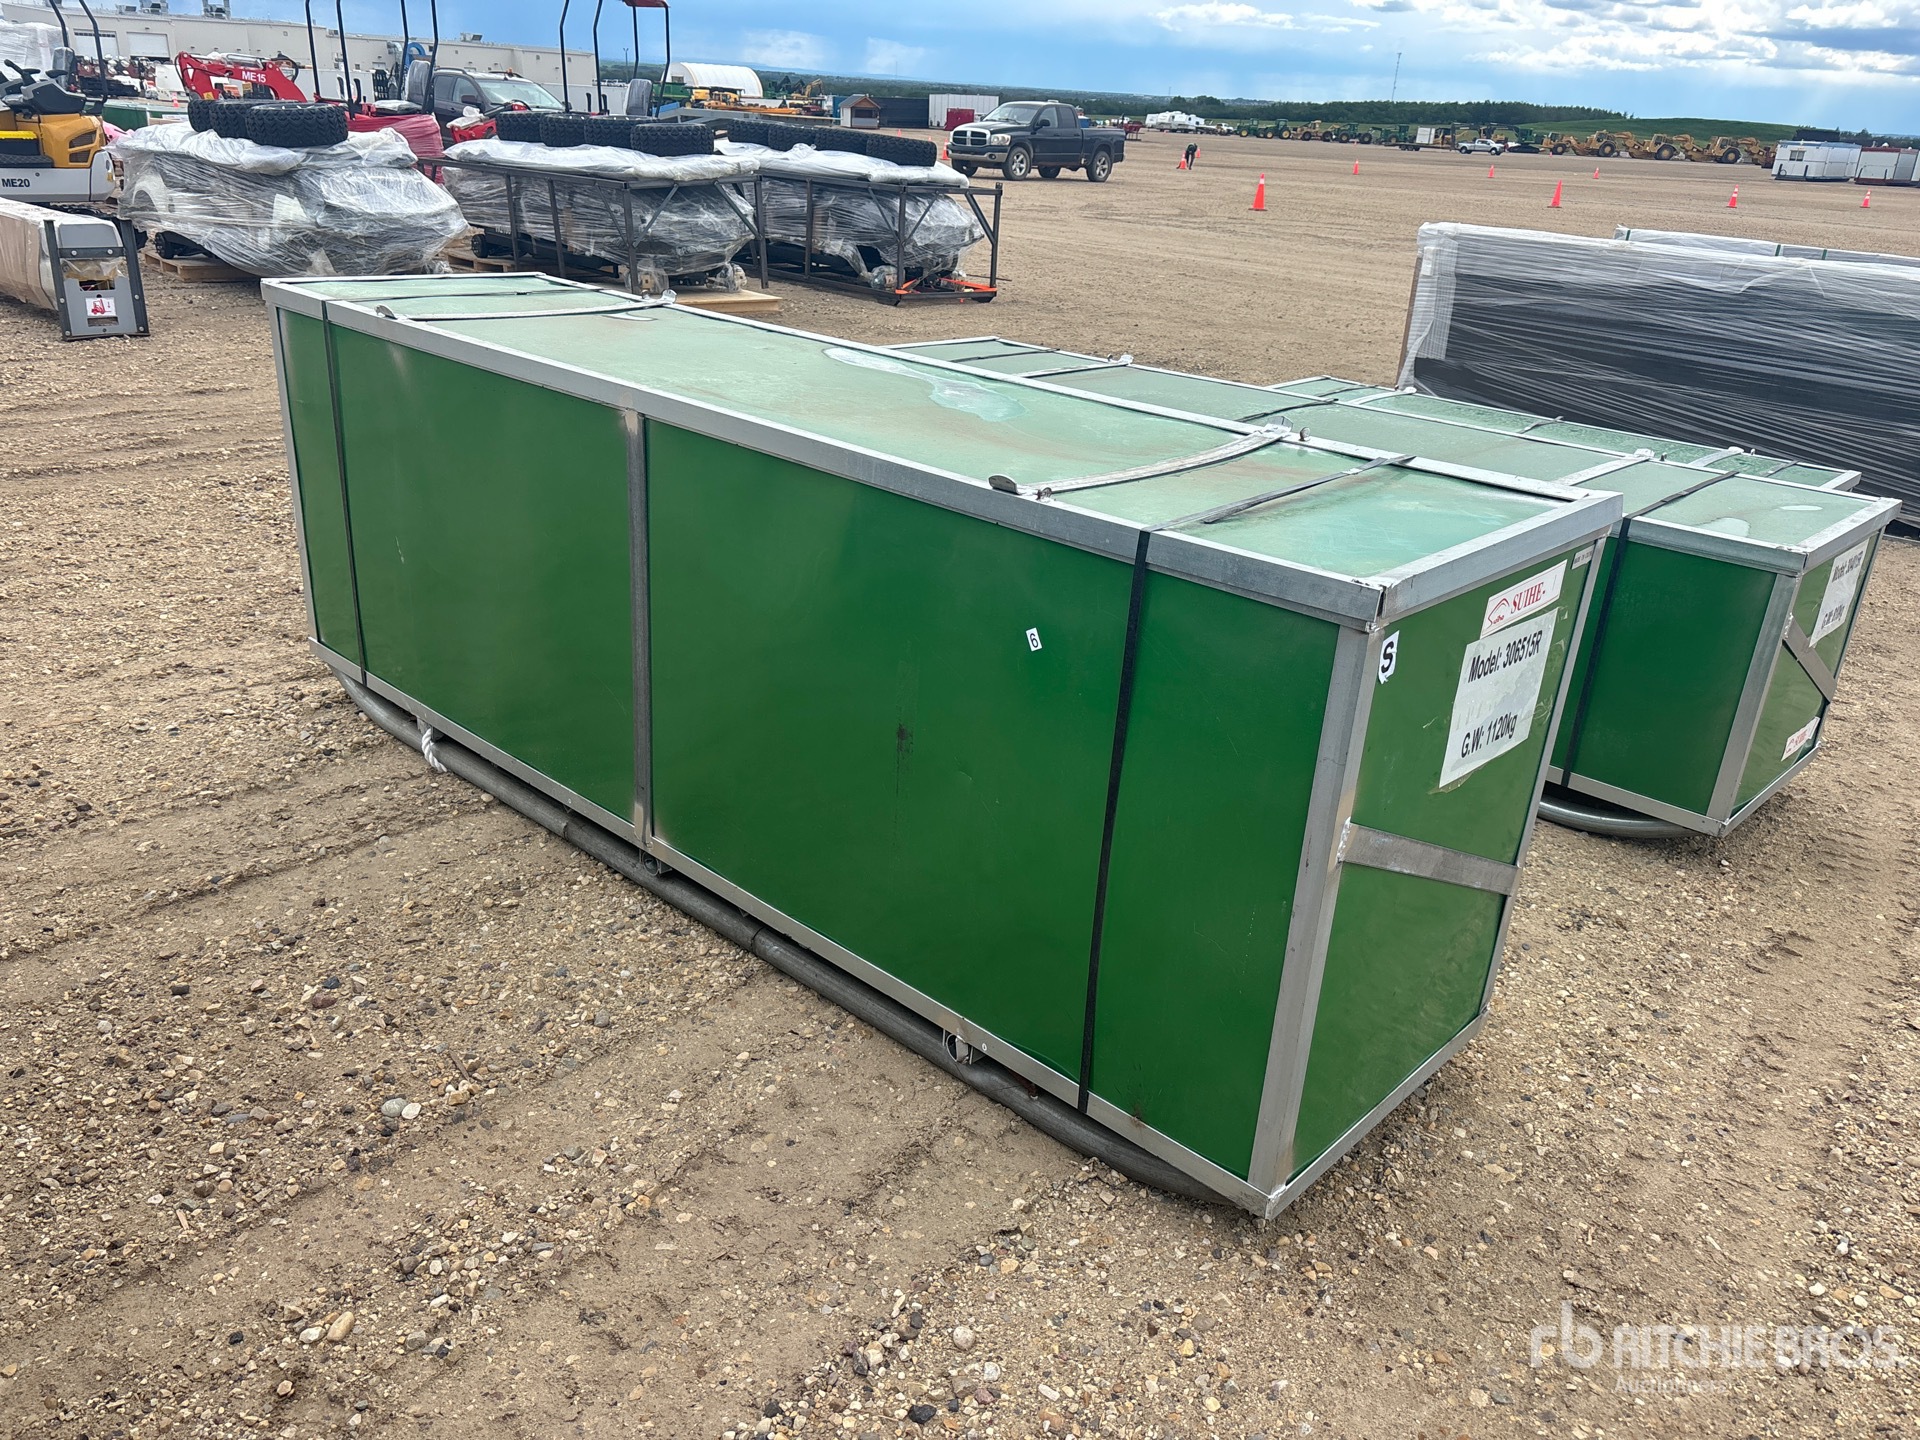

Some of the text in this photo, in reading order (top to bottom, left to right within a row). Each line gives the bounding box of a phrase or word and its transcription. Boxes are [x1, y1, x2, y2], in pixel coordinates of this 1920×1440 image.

[241, 71, 266, 83] ME15
[1, 178, 30, 188] ME20
[1030, 633, 1038, 648] 6
[1381, 641, 1394, 673] S
[1468, 630, 1543, 683] Model: 306515R
[1461, 712, 1518, 758] G.W: 1120kg
